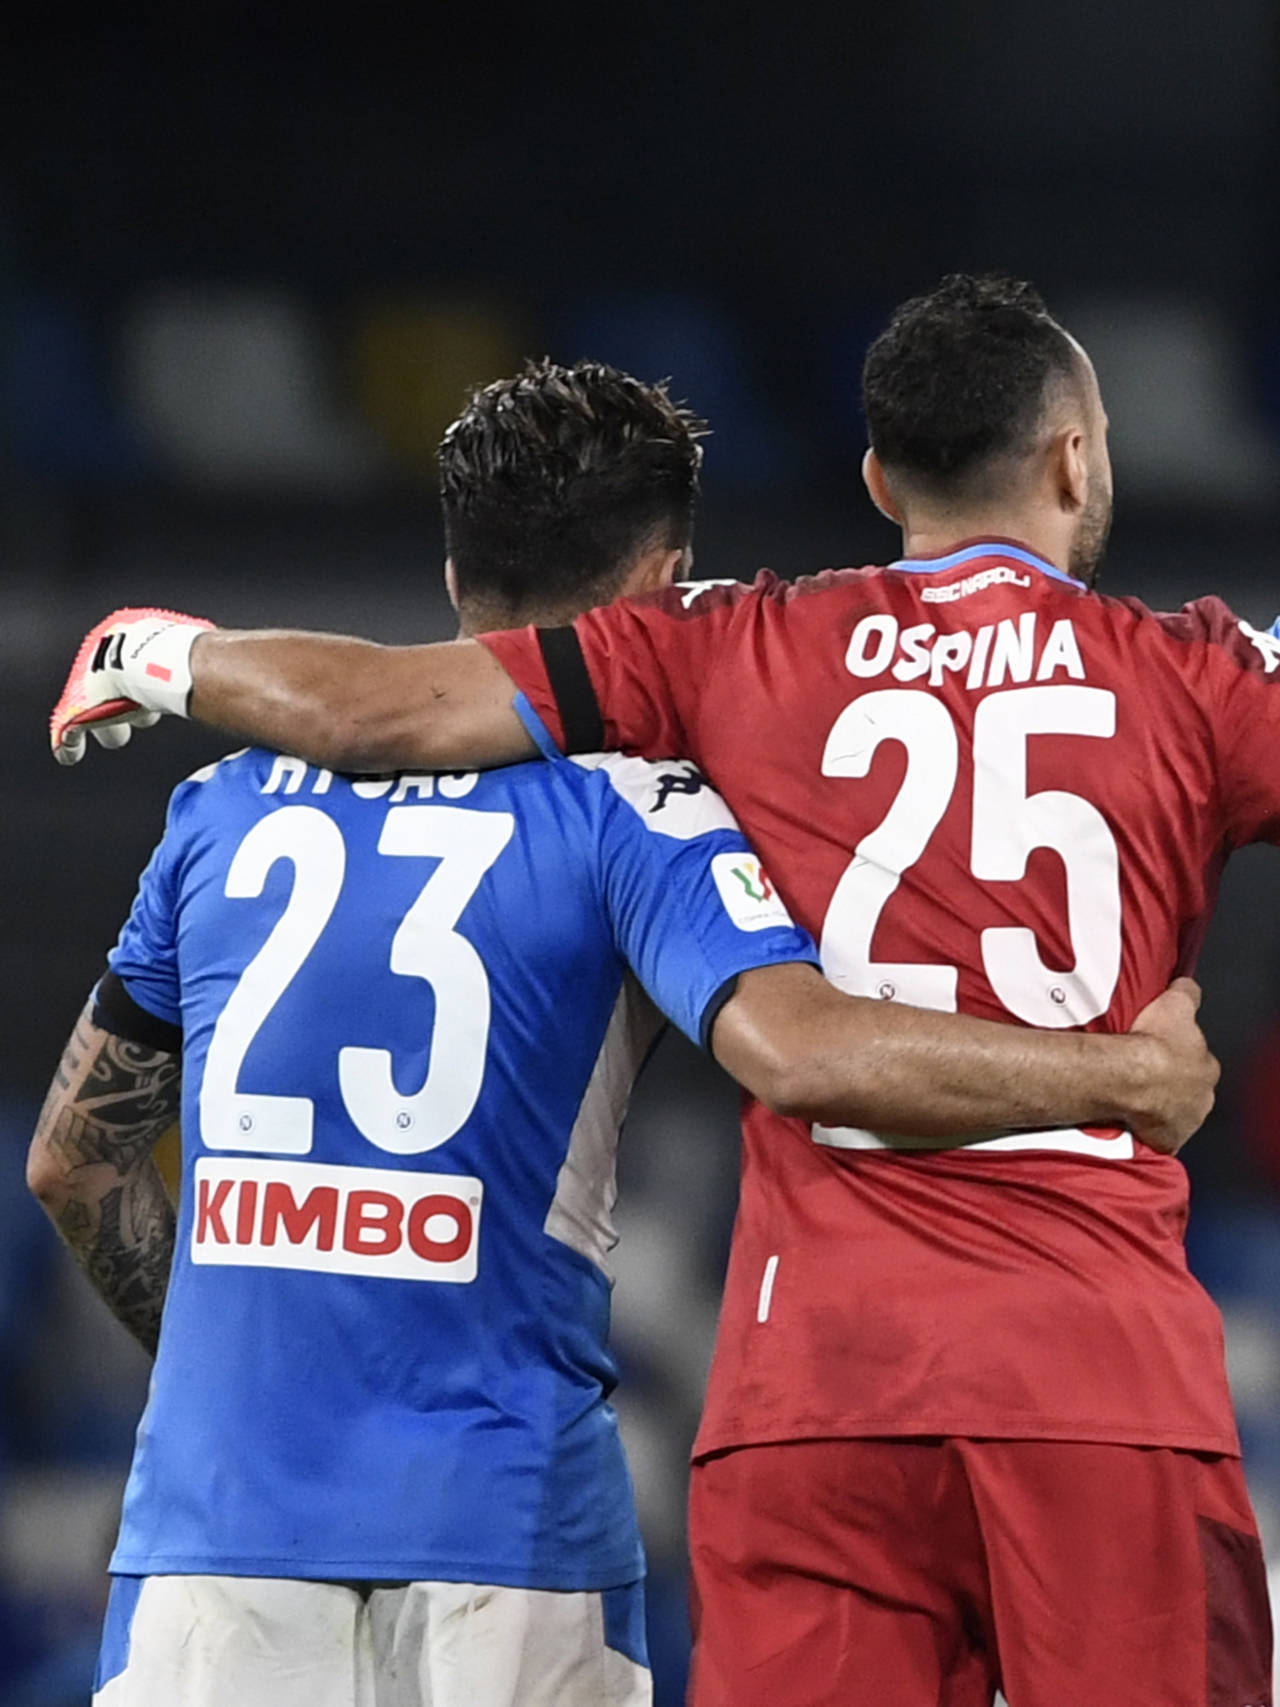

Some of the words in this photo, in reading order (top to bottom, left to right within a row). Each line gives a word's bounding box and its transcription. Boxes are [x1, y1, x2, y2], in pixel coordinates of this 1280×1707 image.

[845, 612, 1086, 690] OSPINA
[820, 685, 1121, 1028] 25
[199, 805, 514, 1154] 23
[196, 1179, 473, 1263] KIMBO
